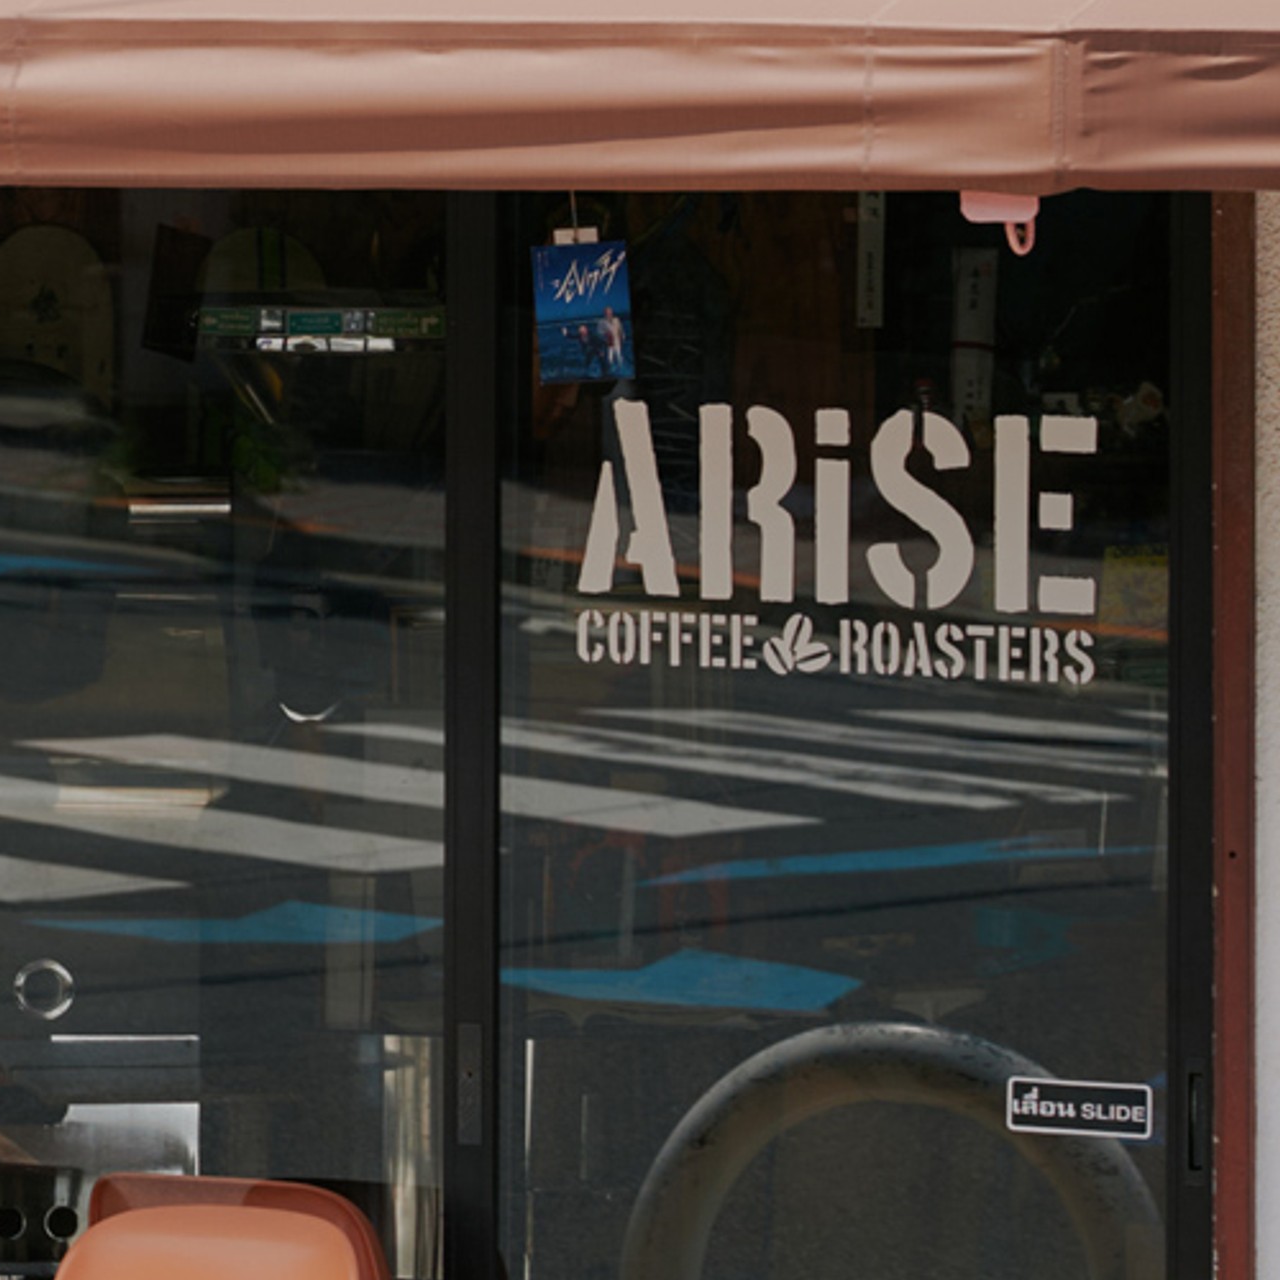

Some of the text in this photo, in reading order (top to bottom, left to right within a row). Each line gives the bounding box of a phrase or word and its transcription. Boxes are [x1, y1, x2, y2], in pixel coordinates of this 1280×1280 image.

[576, 609, 1095, 685] COFFEE ROASTERS
[1081, 1102, 1146, 1123] SLIDE
